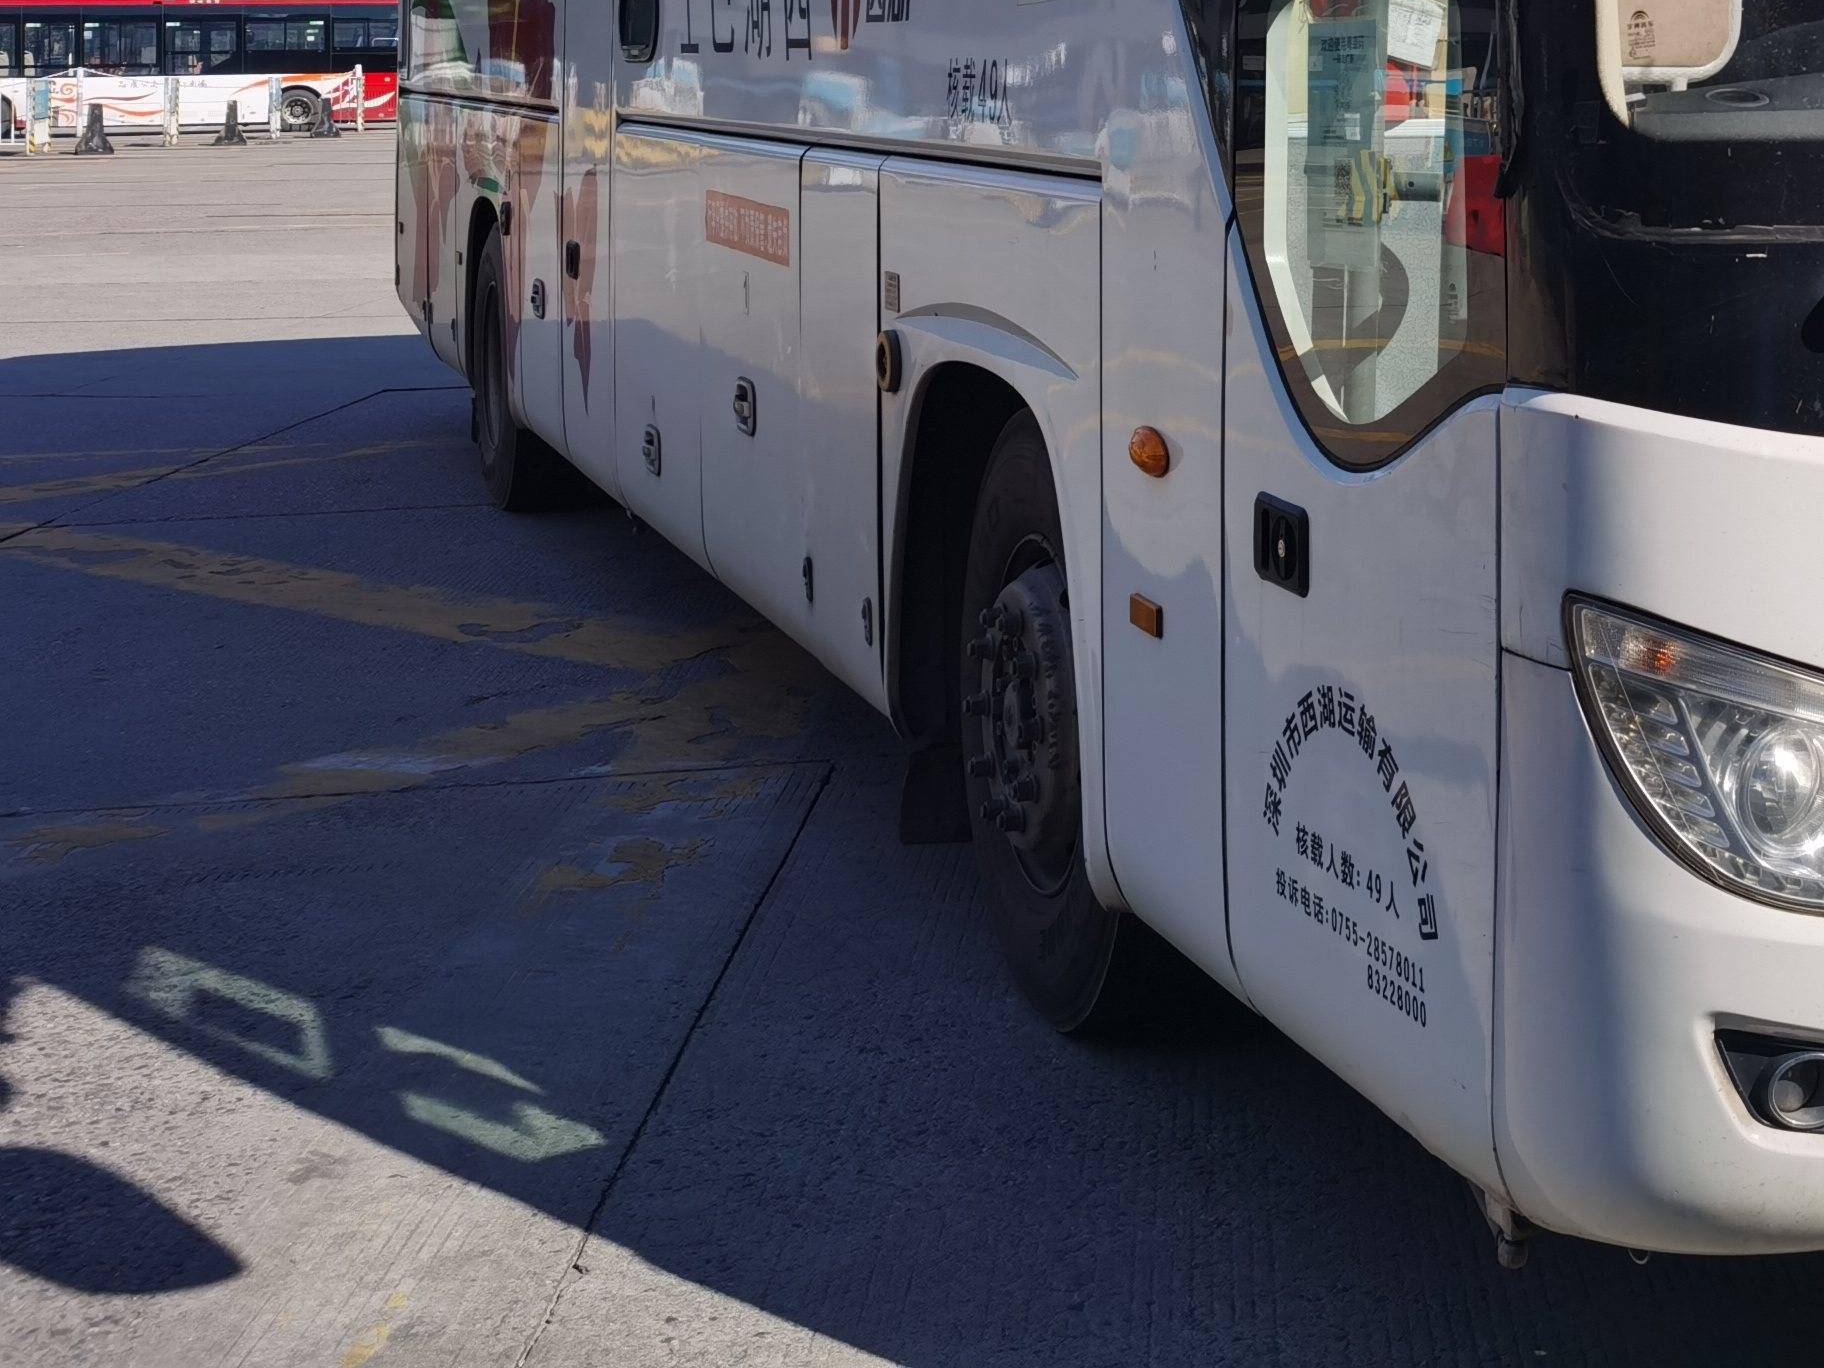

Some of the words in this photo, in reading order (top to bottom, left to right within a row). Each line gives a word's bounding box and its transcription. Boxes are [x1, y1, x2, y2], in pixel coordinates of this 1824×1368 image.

[946, 57, 1014, 127] 核载49人
[1262, 684, 1439, 940] 深圳市西湖运输有限公司
[1367, 963, 1427, 1028] 83228000
